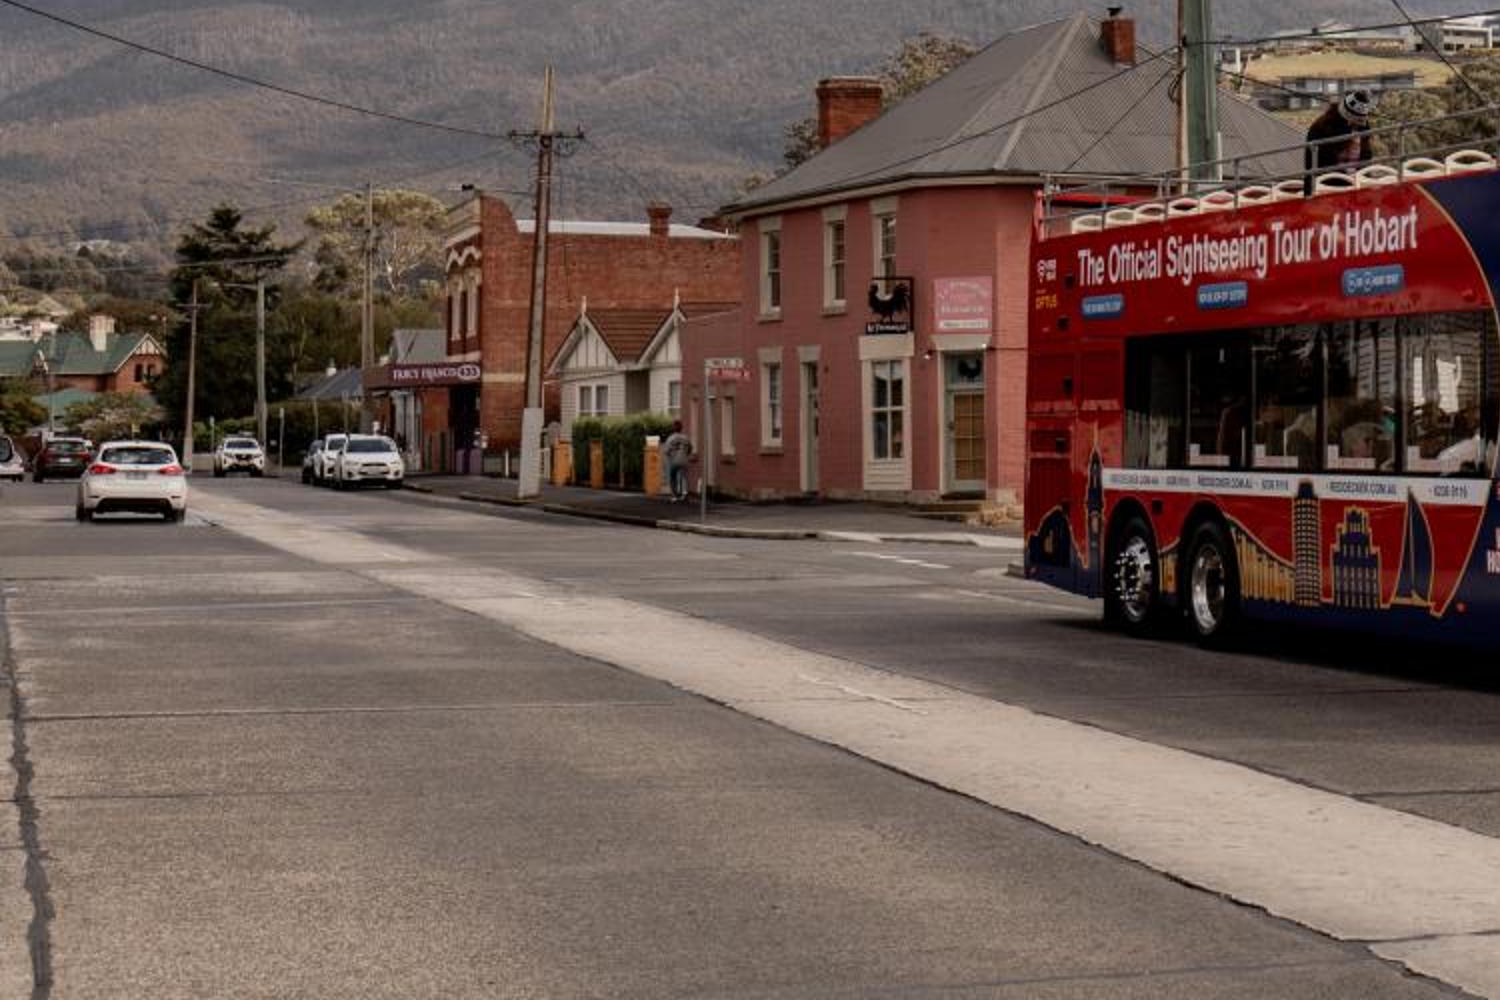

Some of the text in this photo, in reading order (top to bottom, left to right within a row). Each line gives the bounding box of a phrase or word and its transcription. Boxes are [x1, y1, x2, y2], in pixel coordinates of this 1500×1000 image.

[1077, 248, 1104, 287] The
[1108, 238, 1162, 284] Official
[1166, 225, 1268, 286] Sightseeing
[1271, 221, 1315, 265] Tour
[1319, 213, 1340, 259] of
[1345, 205, 1417, 257] Hobart
